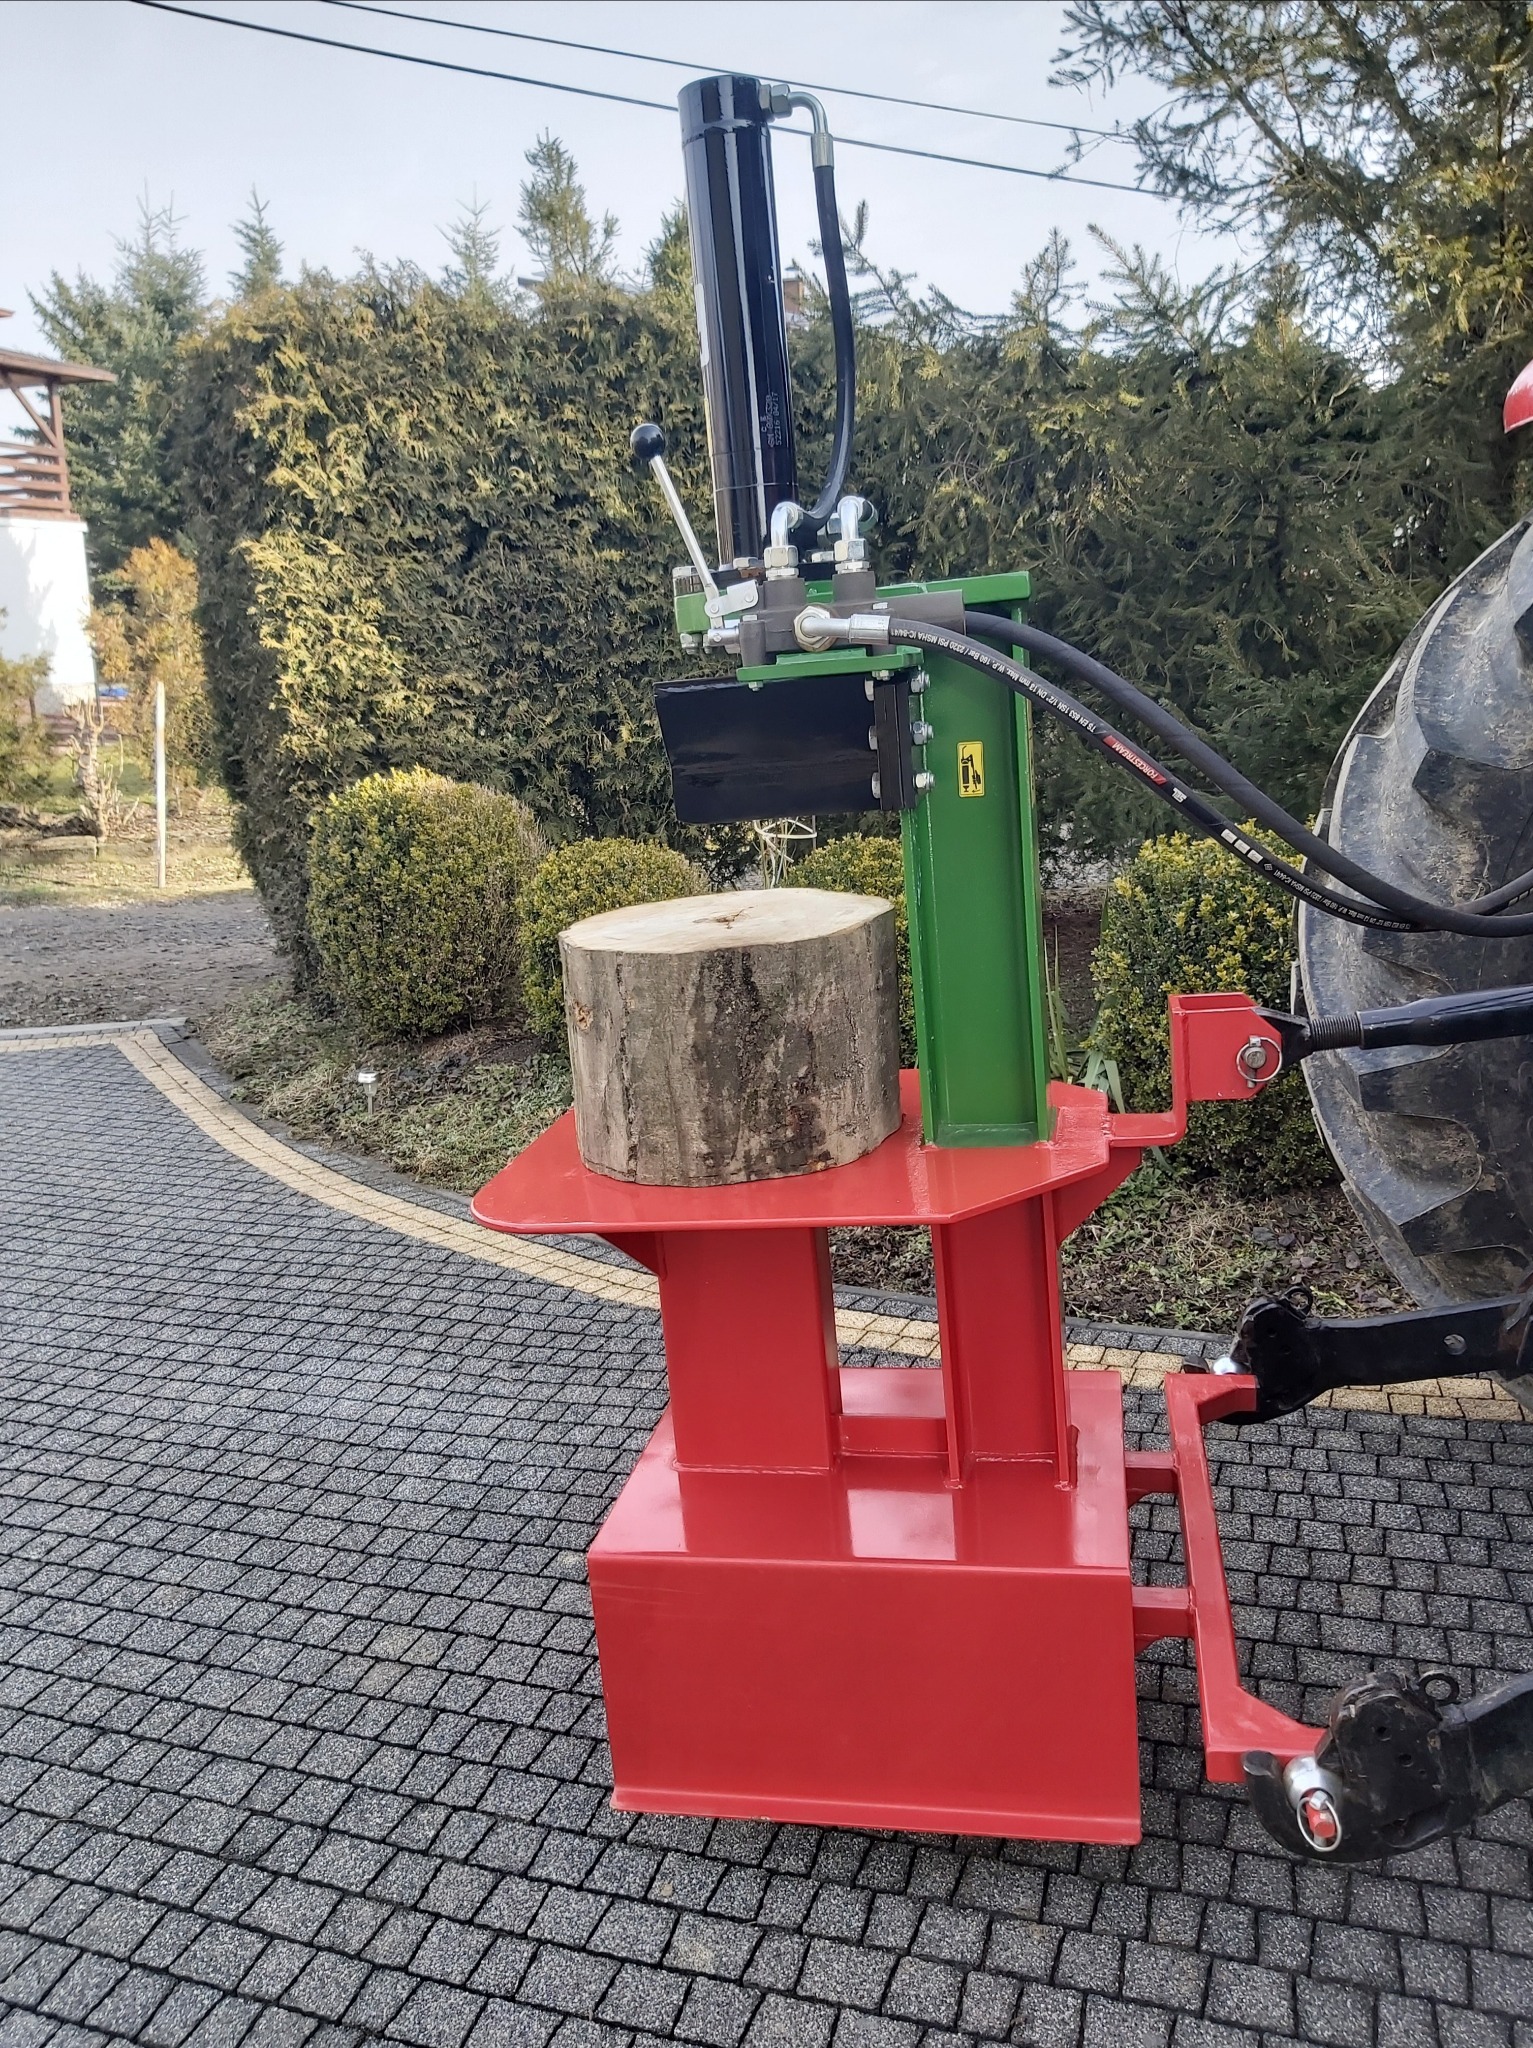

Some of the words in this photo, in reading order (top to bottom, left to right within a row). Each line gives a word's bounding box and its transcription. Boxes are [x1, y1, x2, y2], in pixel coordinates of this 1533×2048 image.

[917, 631, 938, 644] MSHA
[937, 637, 950, 648] PSI
[949, 641, 966, 654] 2320
[967, 649, 980, 660] Bar
[979, 654, 991, 666] 160
[1006, 667, 1020, 681] Max.
[1018, 675, 1031, 687] mm
[1029, 682, 1038, 693] 13
[1036, 688, 1048, 699] DN
[1056, 701, 1070, 714] 1SN
[1078, 715, 1090, 727] EN
[1086, 721, 1097, 733] TS
[1111, 740, 1159, 780] FORCESTREAM
